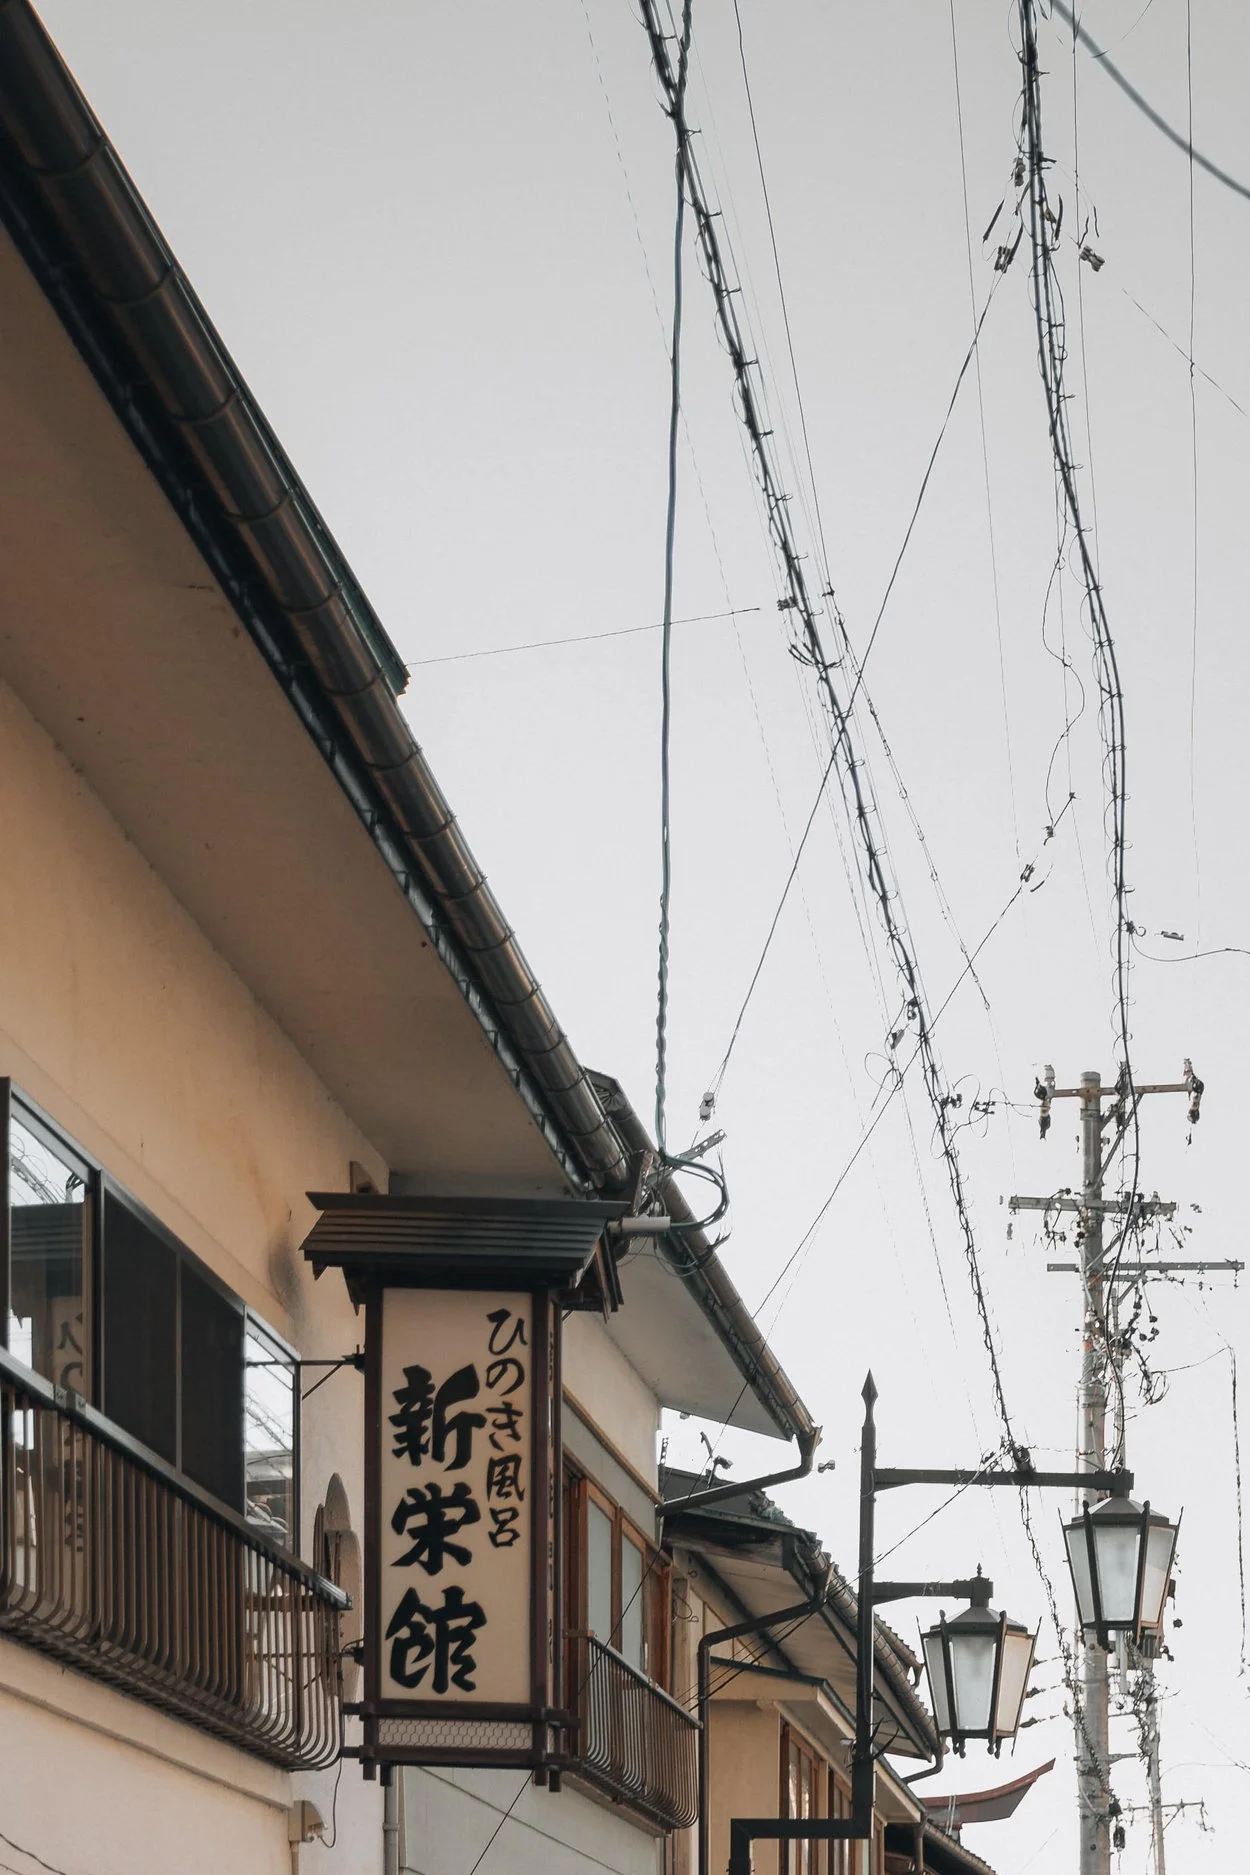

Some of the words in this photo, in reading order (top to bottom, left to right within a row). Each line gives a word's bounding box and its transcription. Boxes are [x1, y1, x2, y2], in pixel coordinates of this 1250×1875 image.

[385, 1363, 488, 1694] 新栄館
[485, 1308, 528, 1548] ひのき風呂
